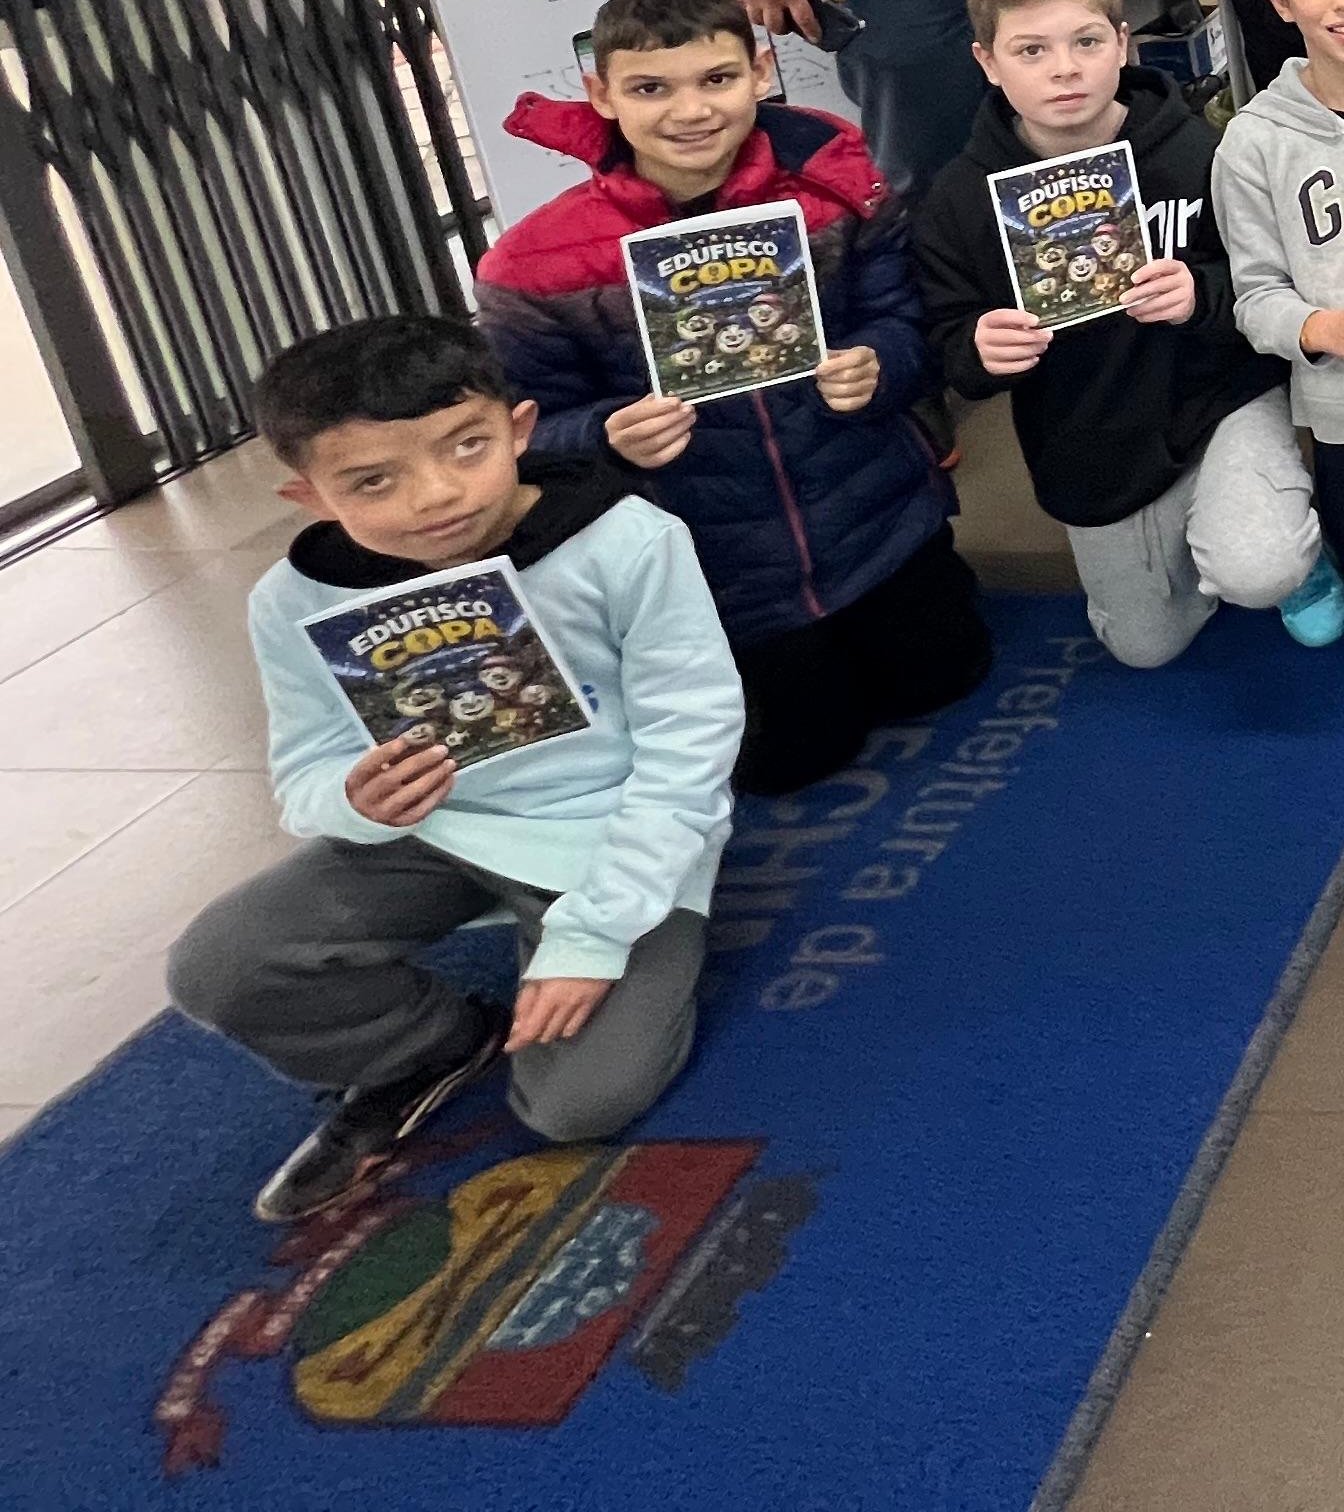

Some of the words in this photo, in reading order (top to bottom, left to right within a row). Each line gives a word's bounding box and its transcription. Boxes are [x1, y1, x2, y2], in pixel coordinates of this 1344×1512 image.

[1018, 173, 1113, 213] EDUFISCO
[1028, 189, 1117, 228] COPA
[657, 240, 779, 278] EDUFISCO
[669, 257, 781, 295] COPA
[349, 600, 493, 657] EDUFISCO
[370, 617, 501, 671] COPA
[837, 636, 1107, 900] Prefeitura
[758, 922, 890, 1012] de
